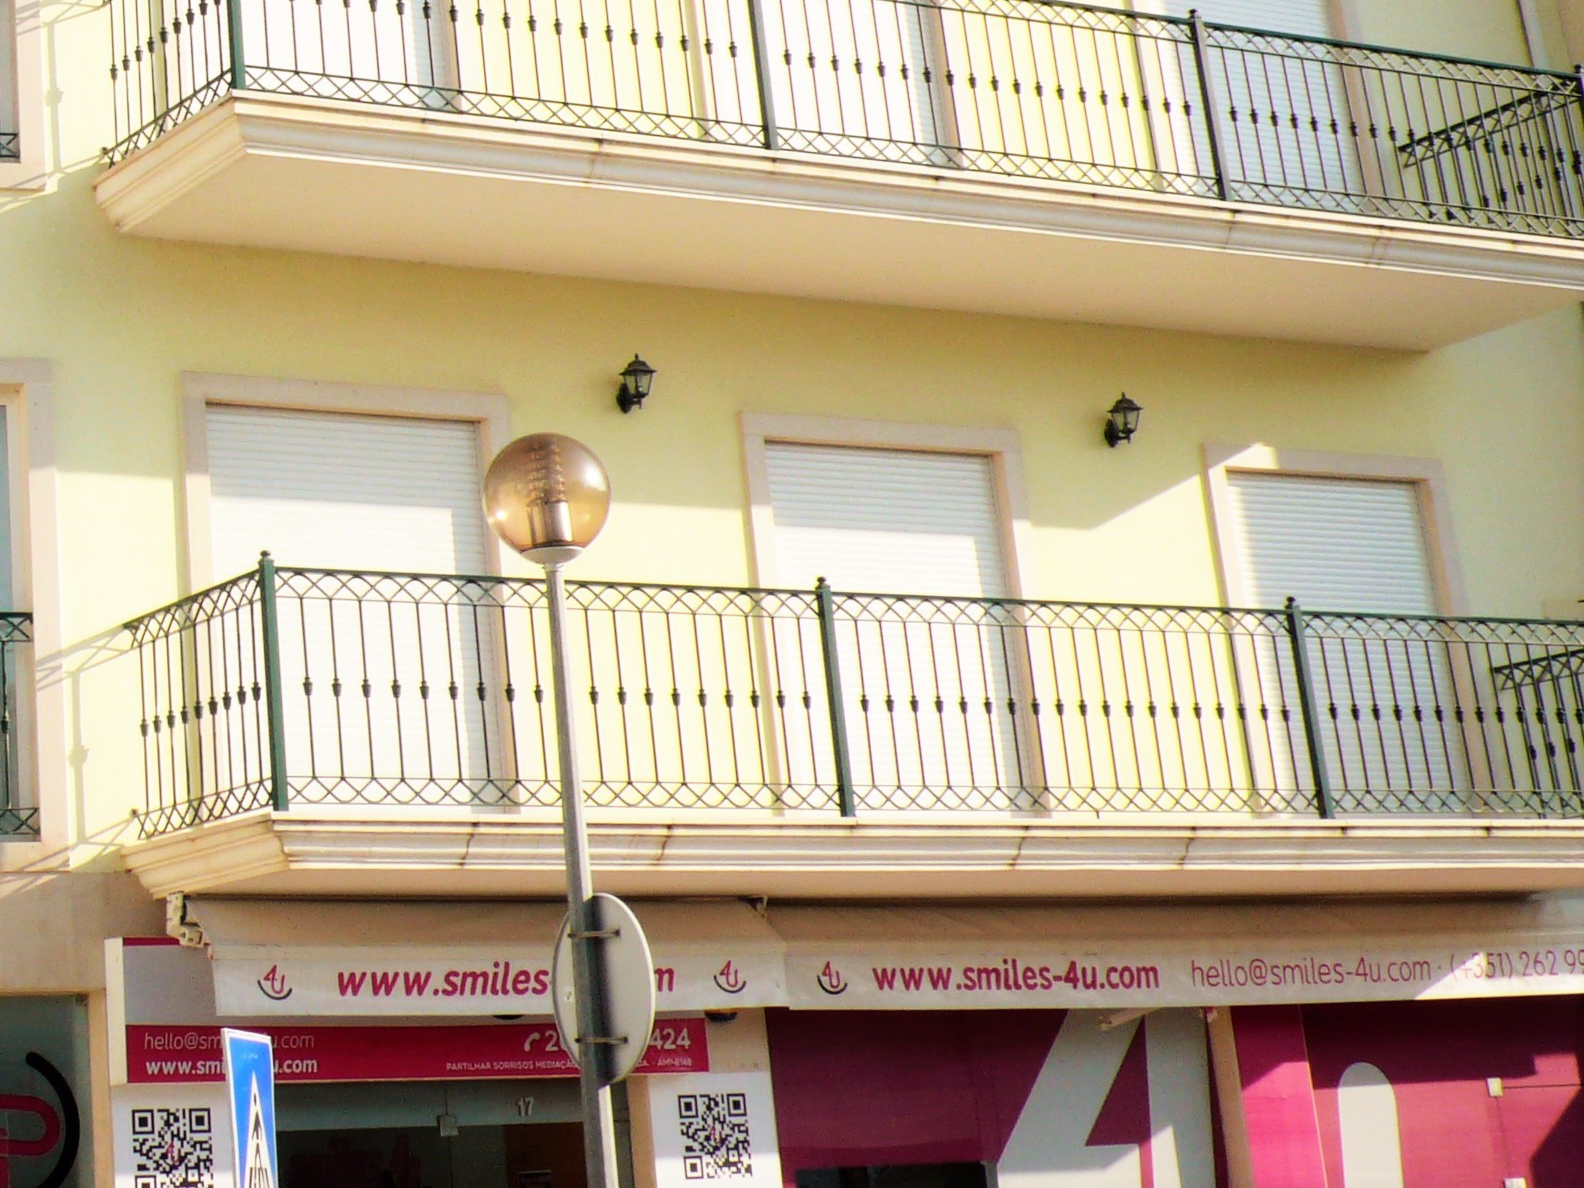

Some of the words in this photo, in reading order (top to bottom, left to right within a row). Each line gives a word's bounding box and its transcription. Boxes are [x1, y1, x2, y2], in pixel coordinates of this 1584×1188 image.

[872, 958, 1159, 991] www.smiles-4u.com
[1191, 956, 1431, 987] hello@smiles-4u.com
[1519, 950, 1559, 977] 262
